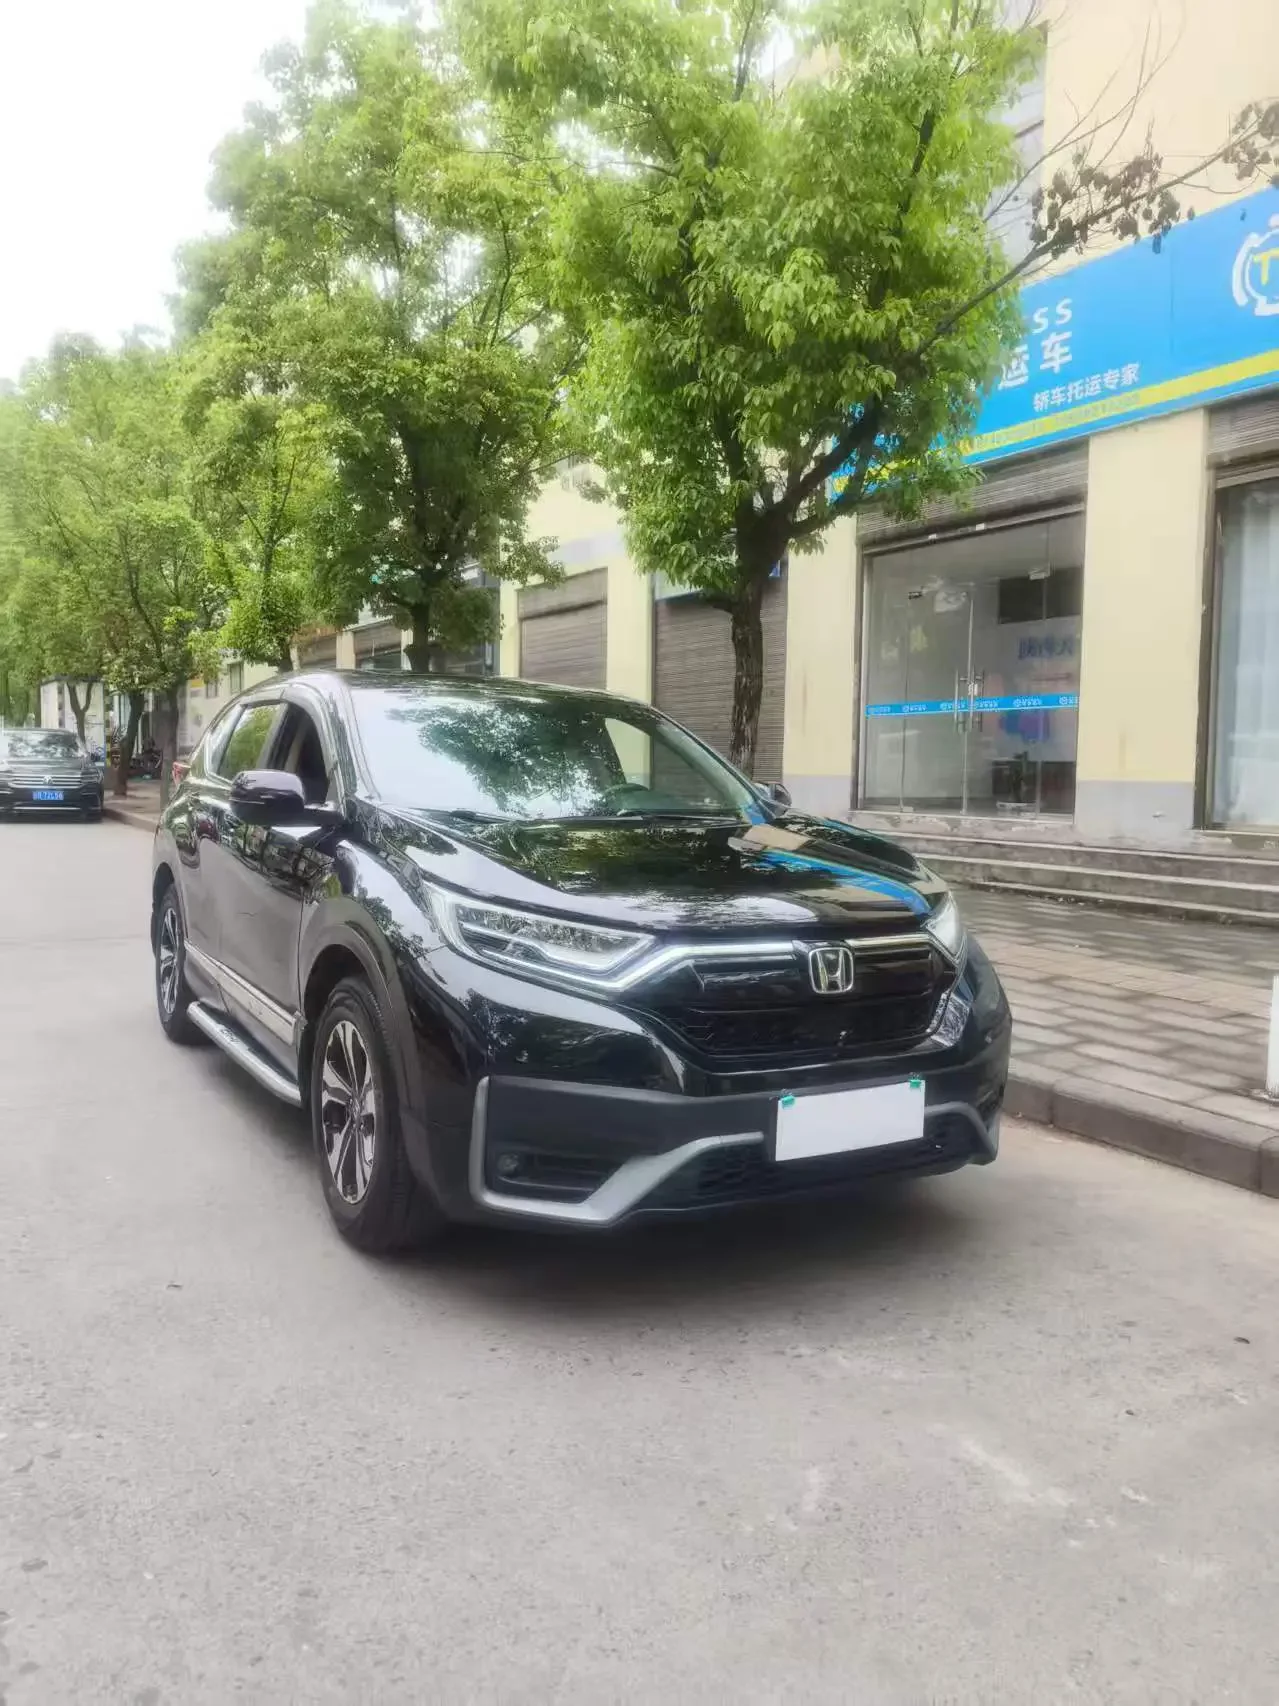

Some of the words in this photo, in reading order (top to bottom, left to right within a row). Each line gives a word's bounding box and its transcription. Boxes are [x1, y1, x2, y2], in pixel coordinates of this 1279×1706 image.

[1033, 361, 1140, 412] 轿车托运专家
